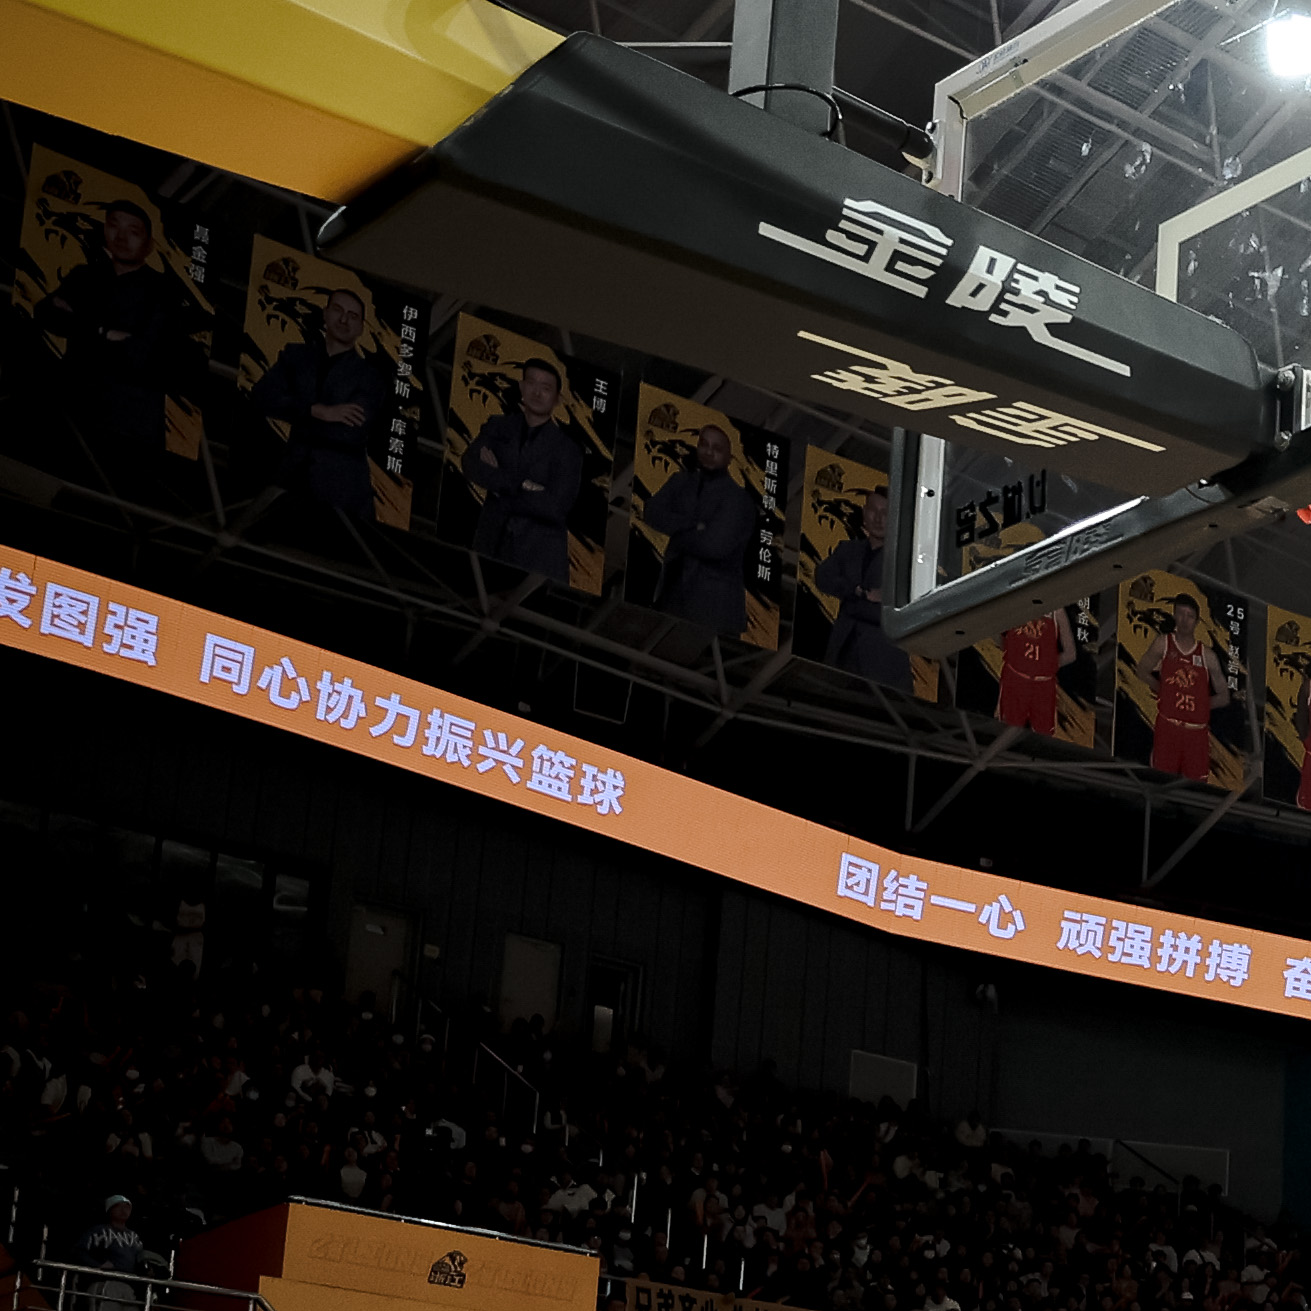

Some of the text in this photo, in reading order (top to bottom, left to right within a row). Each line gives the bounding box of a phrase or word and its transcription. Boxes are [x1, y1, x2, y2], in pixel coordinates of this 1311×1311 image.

[758, 197, 1132, 378] 金陵
[592, 377, 609, 413] 王博
[199, 632, 627, 816] 同心协力振兴篮球
[836, 852, 1027, 941] 团结一心
[1056, 909, 1254, 988] 顽强拼搏
